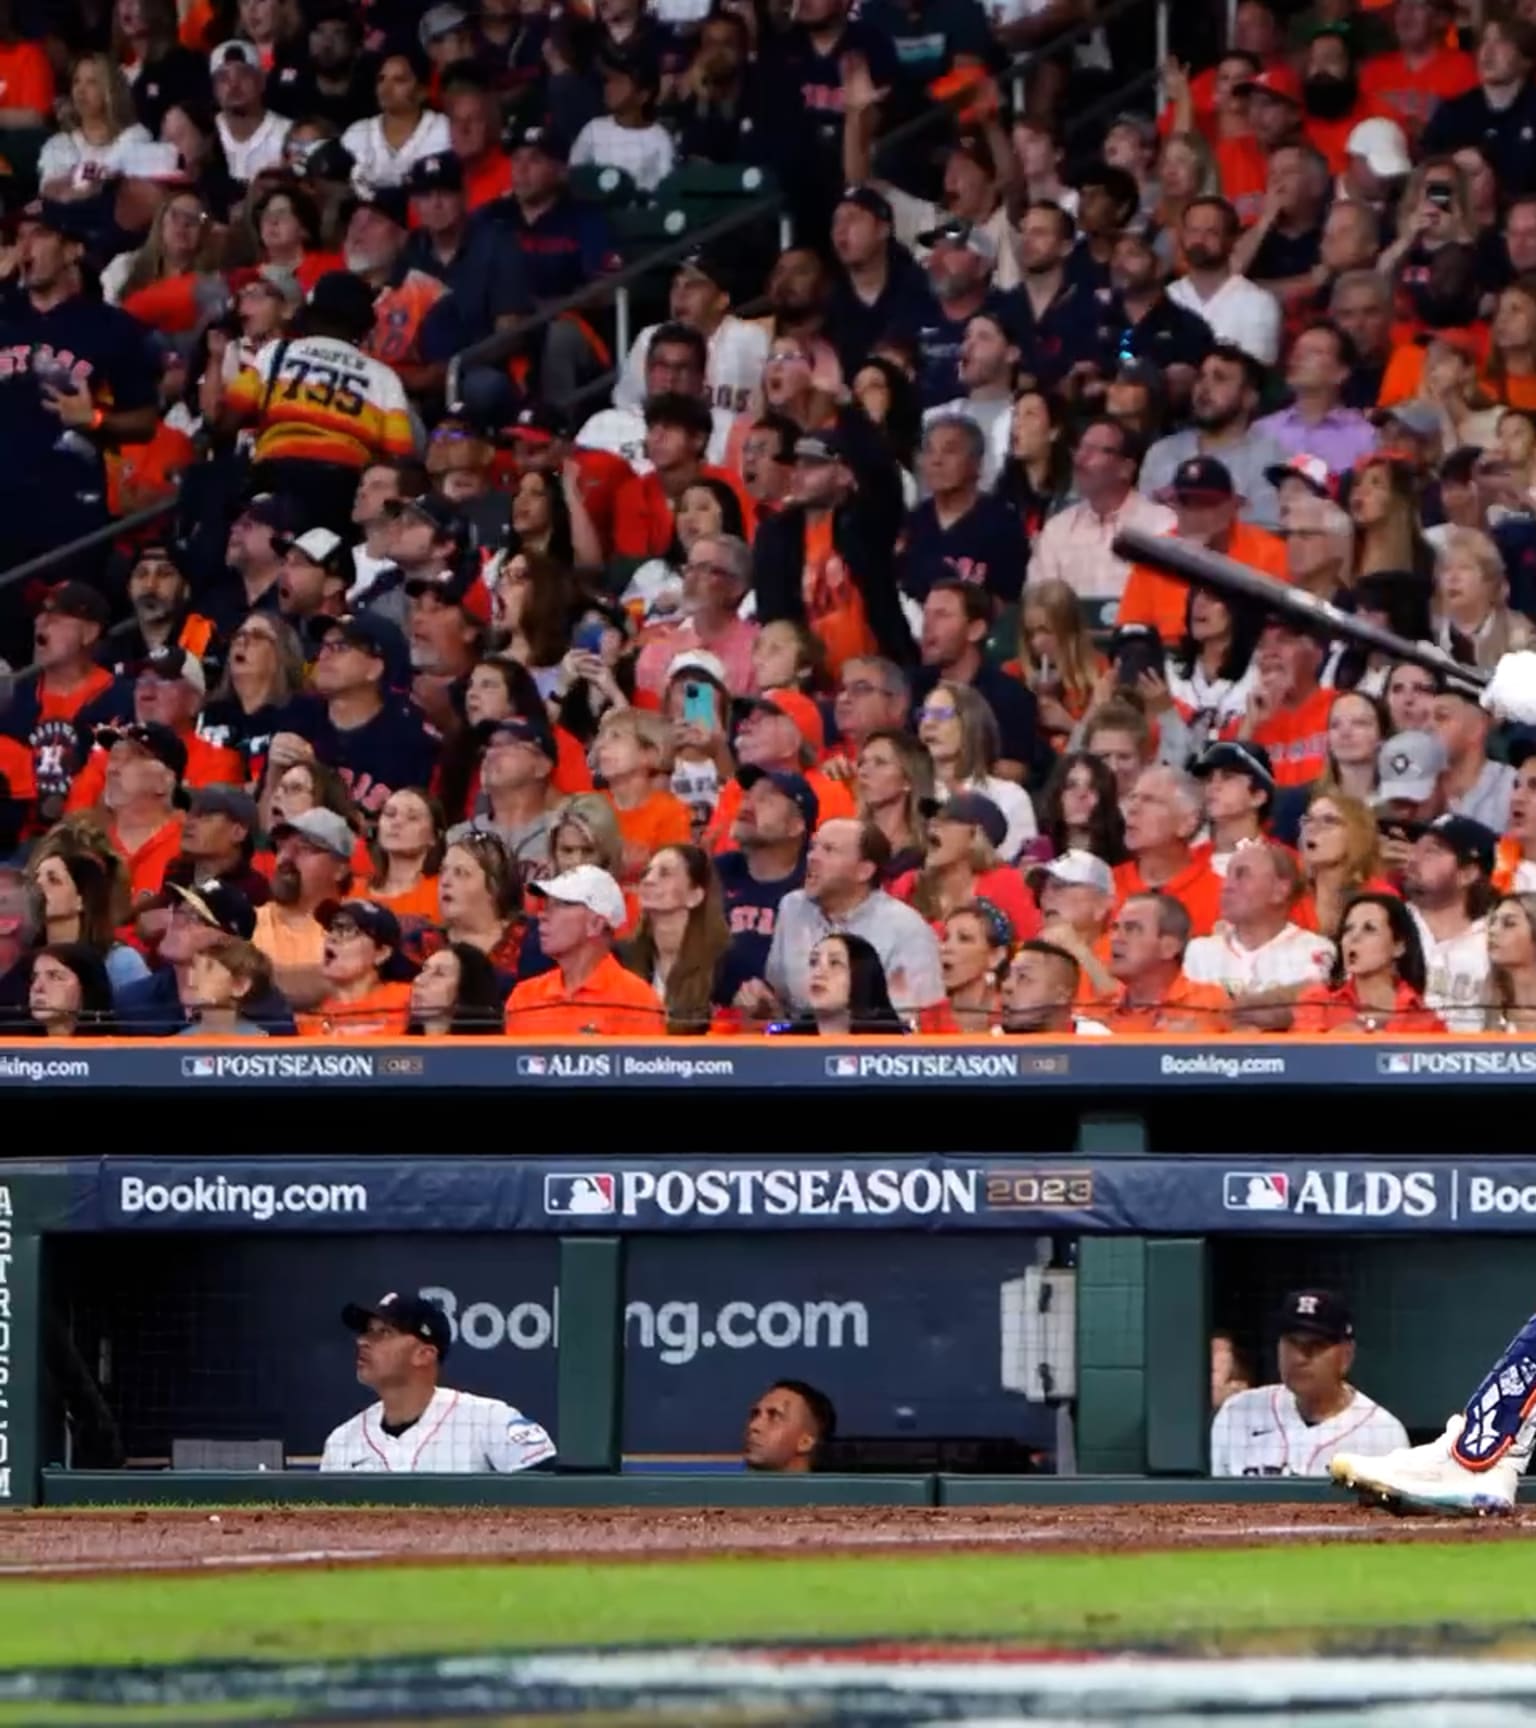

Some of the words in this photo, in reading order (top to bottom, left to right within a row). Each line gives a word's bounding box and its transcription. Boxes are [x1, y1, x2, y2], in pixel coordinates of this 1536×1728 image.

[286, 358, 369, 417] 735
[216, 1055, 373, 1076] POSTSEASON
[548, 1054, 610, 1076] ALDS
[624, 1056, 733, 1078] Booking.com
[859, 1054, 1018, 1076] POSTSEASON
[1160, 1054, 1285, 1078] Booking.com
[121, 1175, 367, 1220] Booking.com
[622, 1169, 976, 1216] POSTSEASON
[986, 1179, 1093, 1204] 2023
[1294, 1170, 1437, 1216] ALDS
